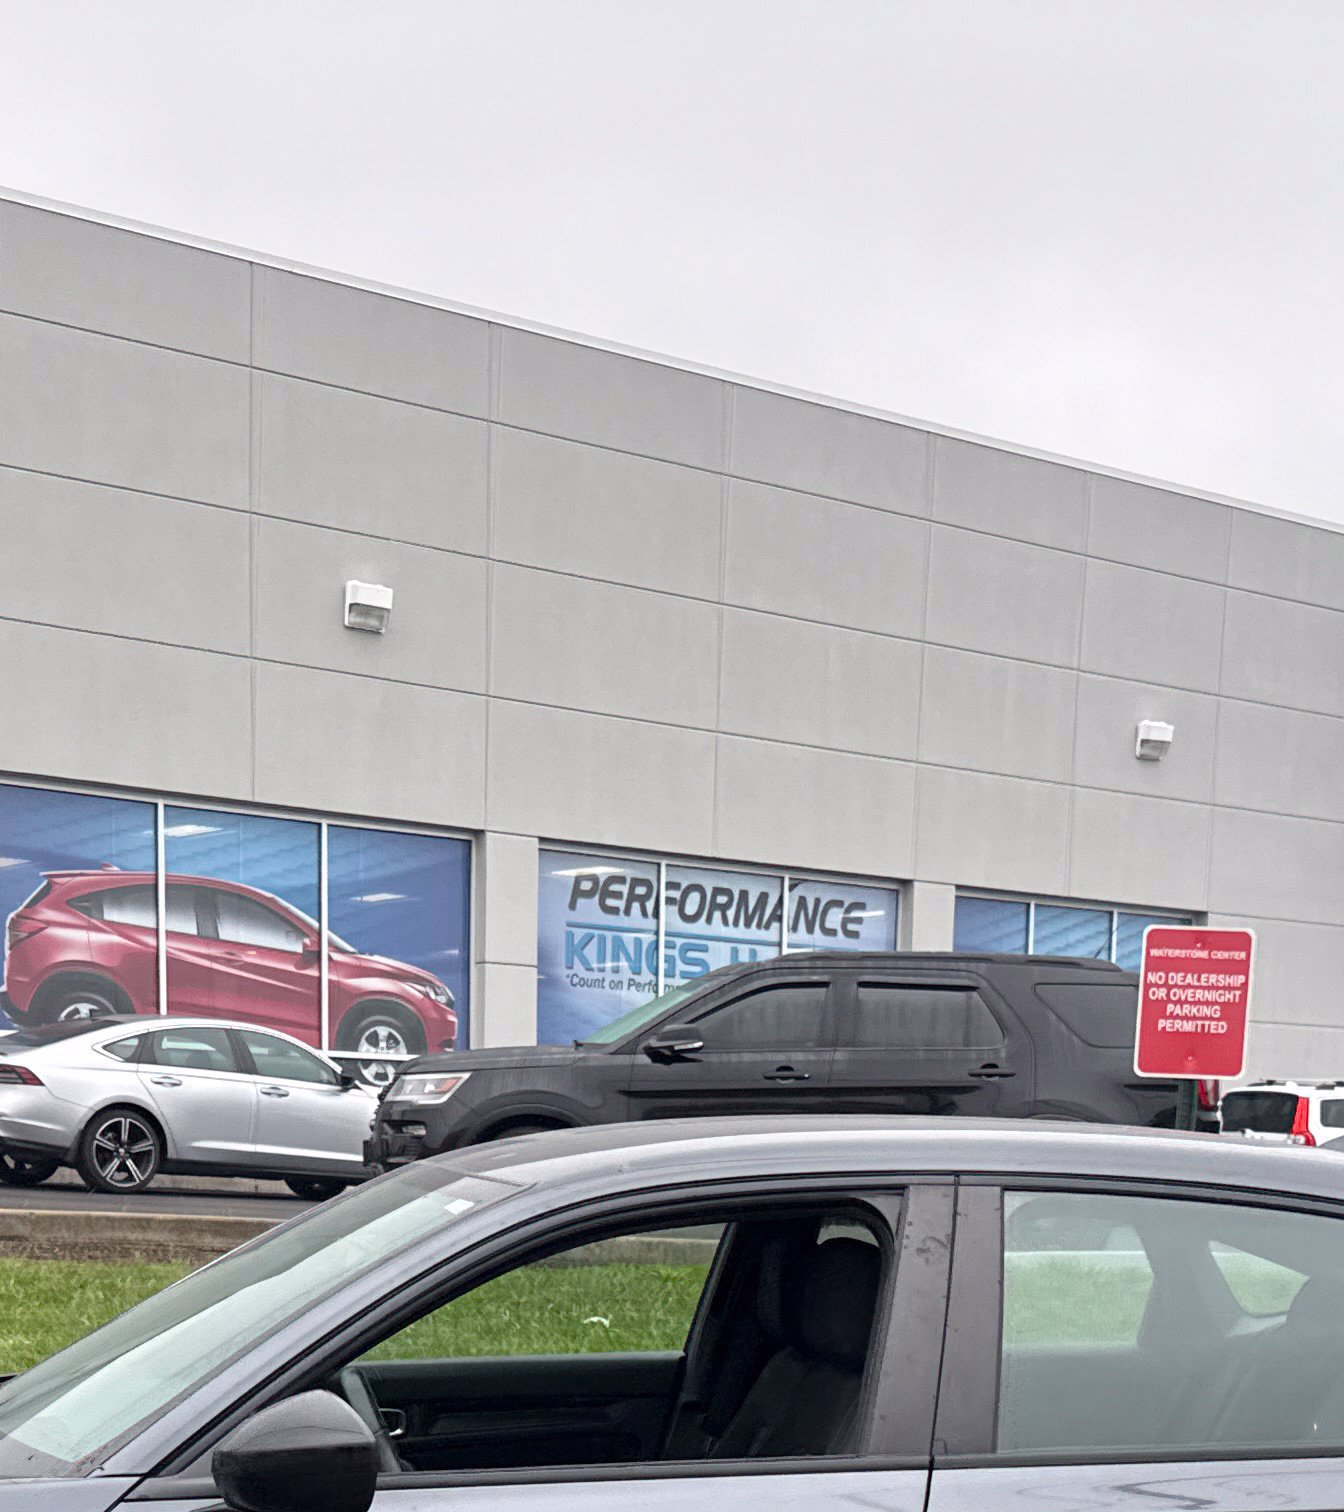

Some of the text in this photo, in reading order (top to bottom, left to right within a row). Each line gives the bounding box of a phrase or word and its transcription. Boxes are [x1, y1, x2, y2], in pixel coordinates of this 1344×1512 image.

[568, 873, 867, 938] PERFORMANCE
[564, 930, 711, 980] KINGS
[1150, 949, 1246, 960] WATERSTONE CENTER
[608, 979, 624, 991] on
[1147, 972, 1246, 987] NO DEALERSHIP
[1149, 988, 1242, 1003] OR OVERNIGHT
[1166, 1004, 1221, 1018] PARKING
[1157, 1019, 1228, 1034] PERMITTED
